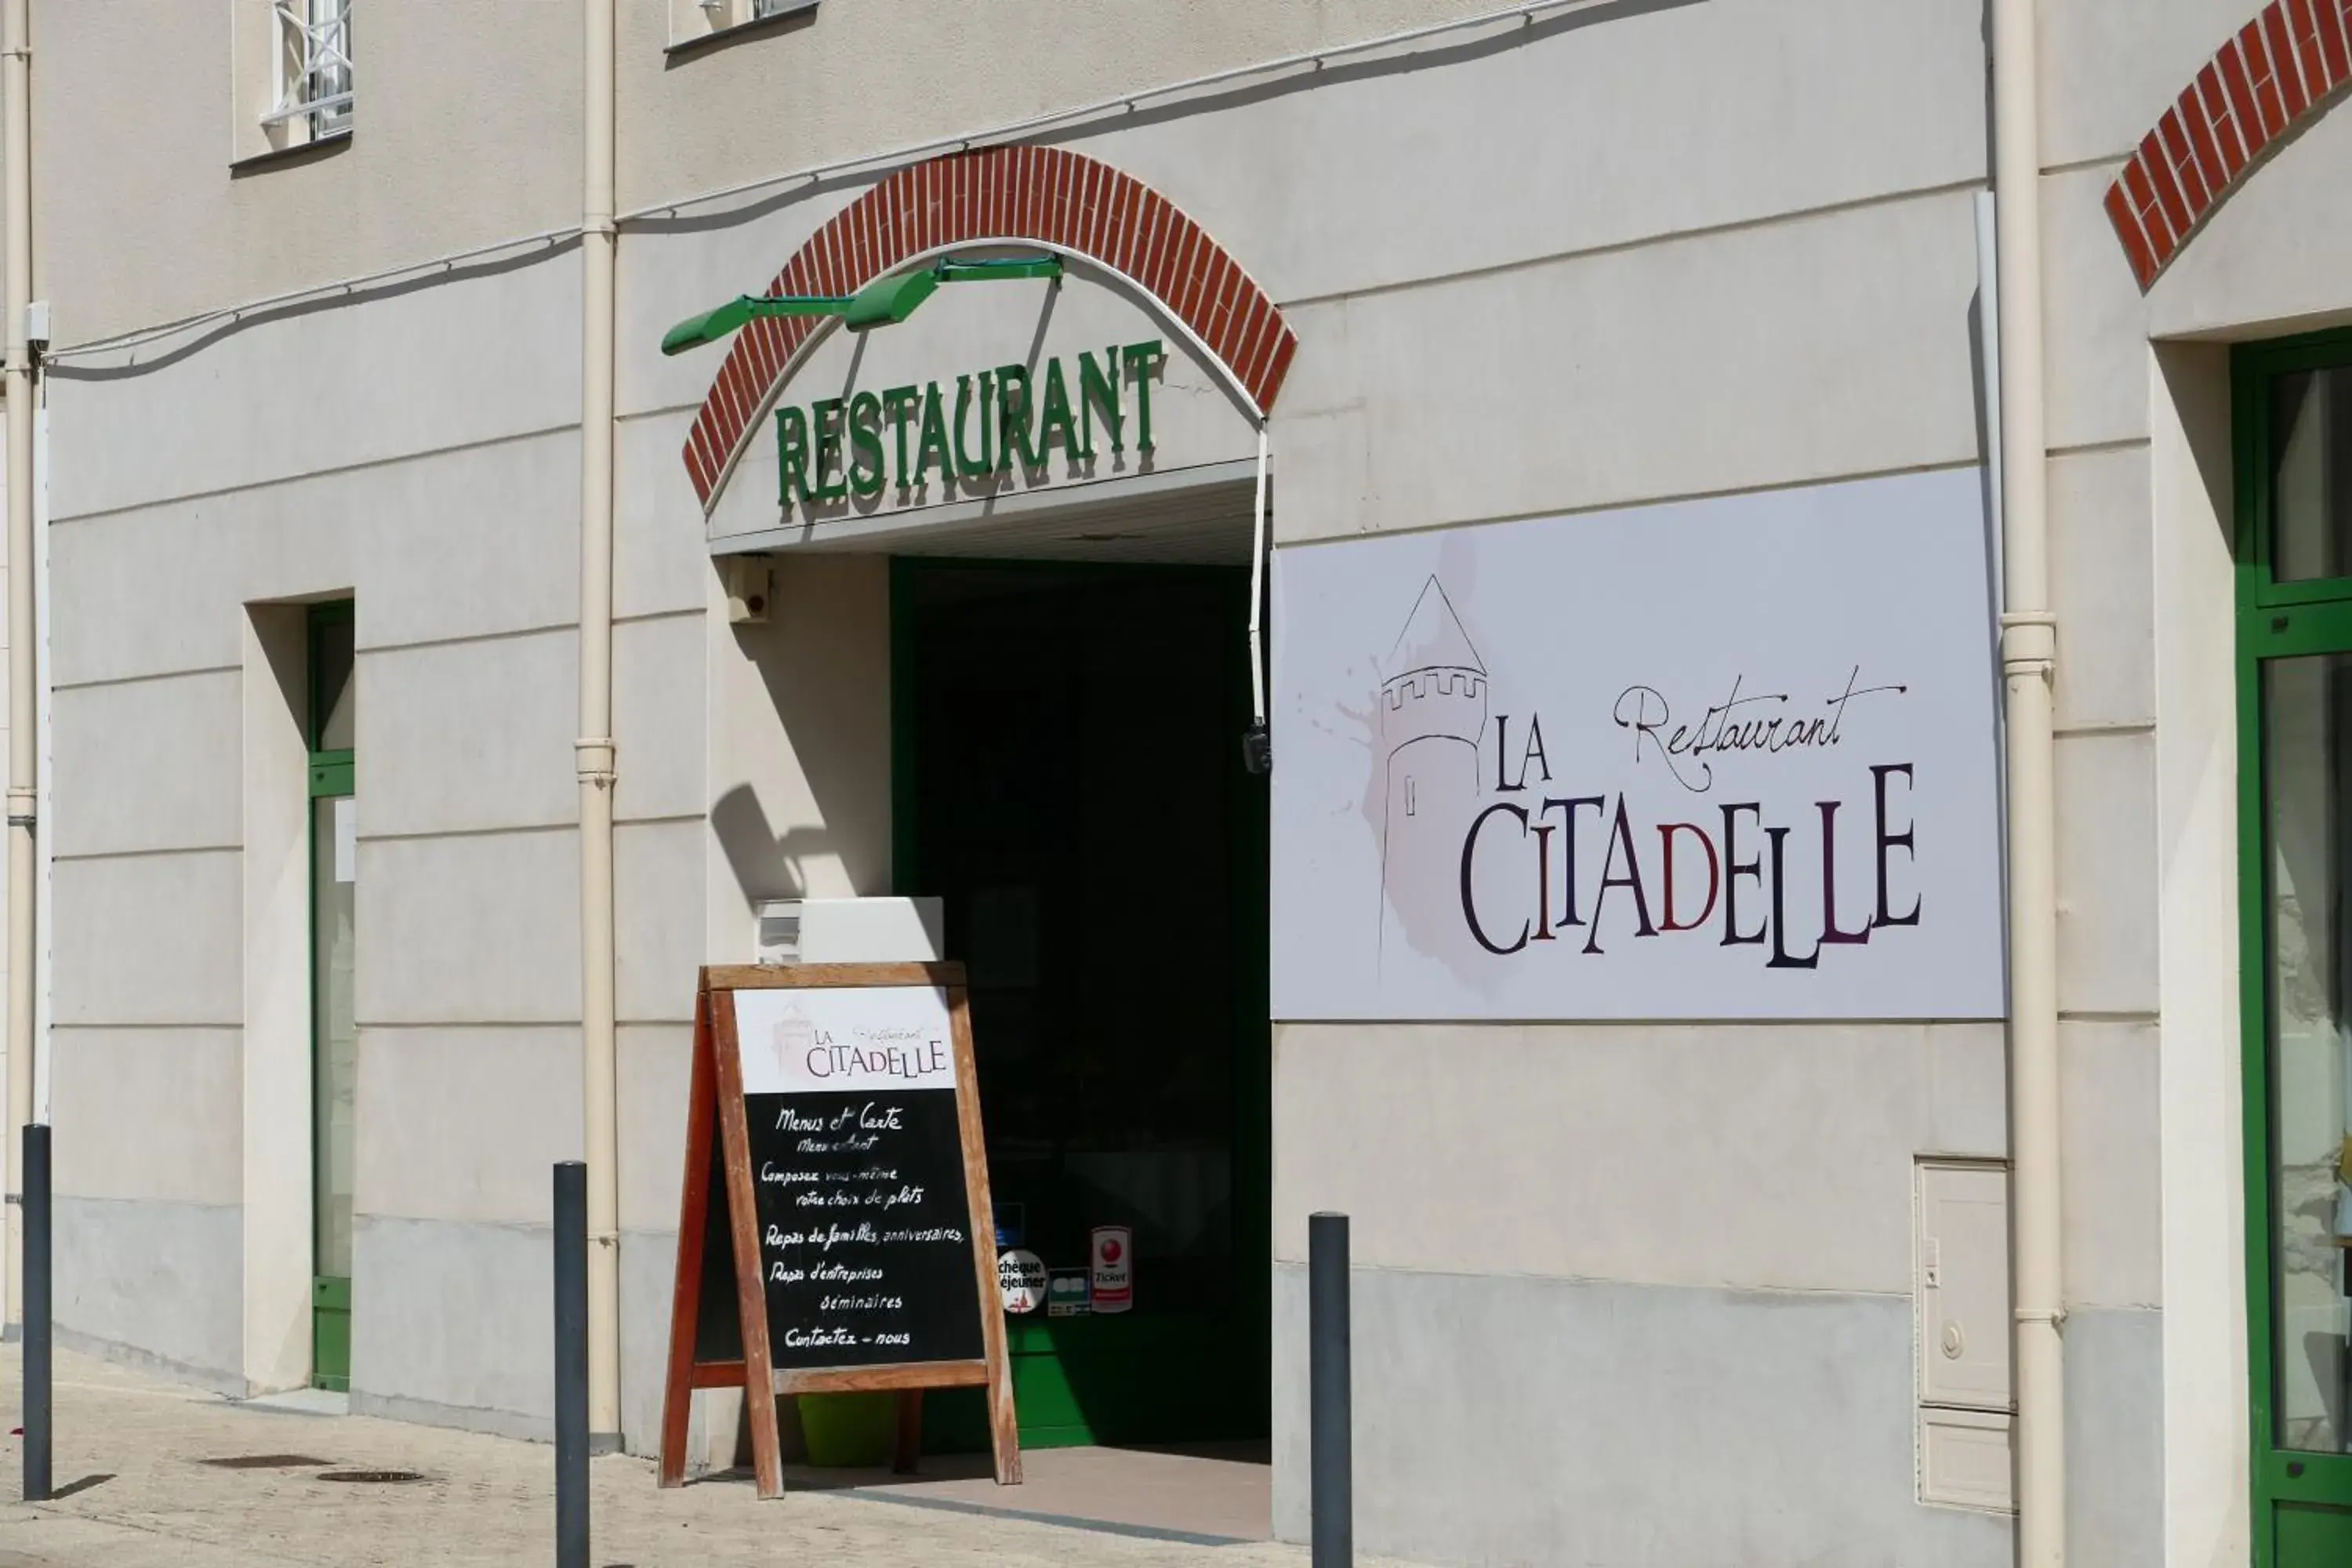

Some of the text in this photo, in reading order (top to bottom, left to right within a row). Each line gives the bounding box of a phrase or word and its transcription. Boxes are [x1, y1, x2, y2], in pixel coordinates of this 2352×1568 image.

[774, 339, 1163, 507] RESTAURANT
[1613, 666, 1907, 793] Restaurant
[1495, 712, 1552, 792] LA
[1460, 763, 1922, 970] CITADELLE
[815, 1029, 833, 1045] LA
[807, 1040, 946, 1079] CITADELLE
[775, 1102, 902, 1131] Menus et Carte
[761, 1161, 819, 1186] Composez
[828, 1189, 859, 1206] choix
[865, 1189, 881, 1204] de
[765, 1224, 804, 1250] Repas
[808, 1227, 825, 1244] de
[769, 1261, 804, 1287] Repas
[998, 1260, 1040, 1278] chèque
[999, 1274, 1046, 1291] éjeuner
